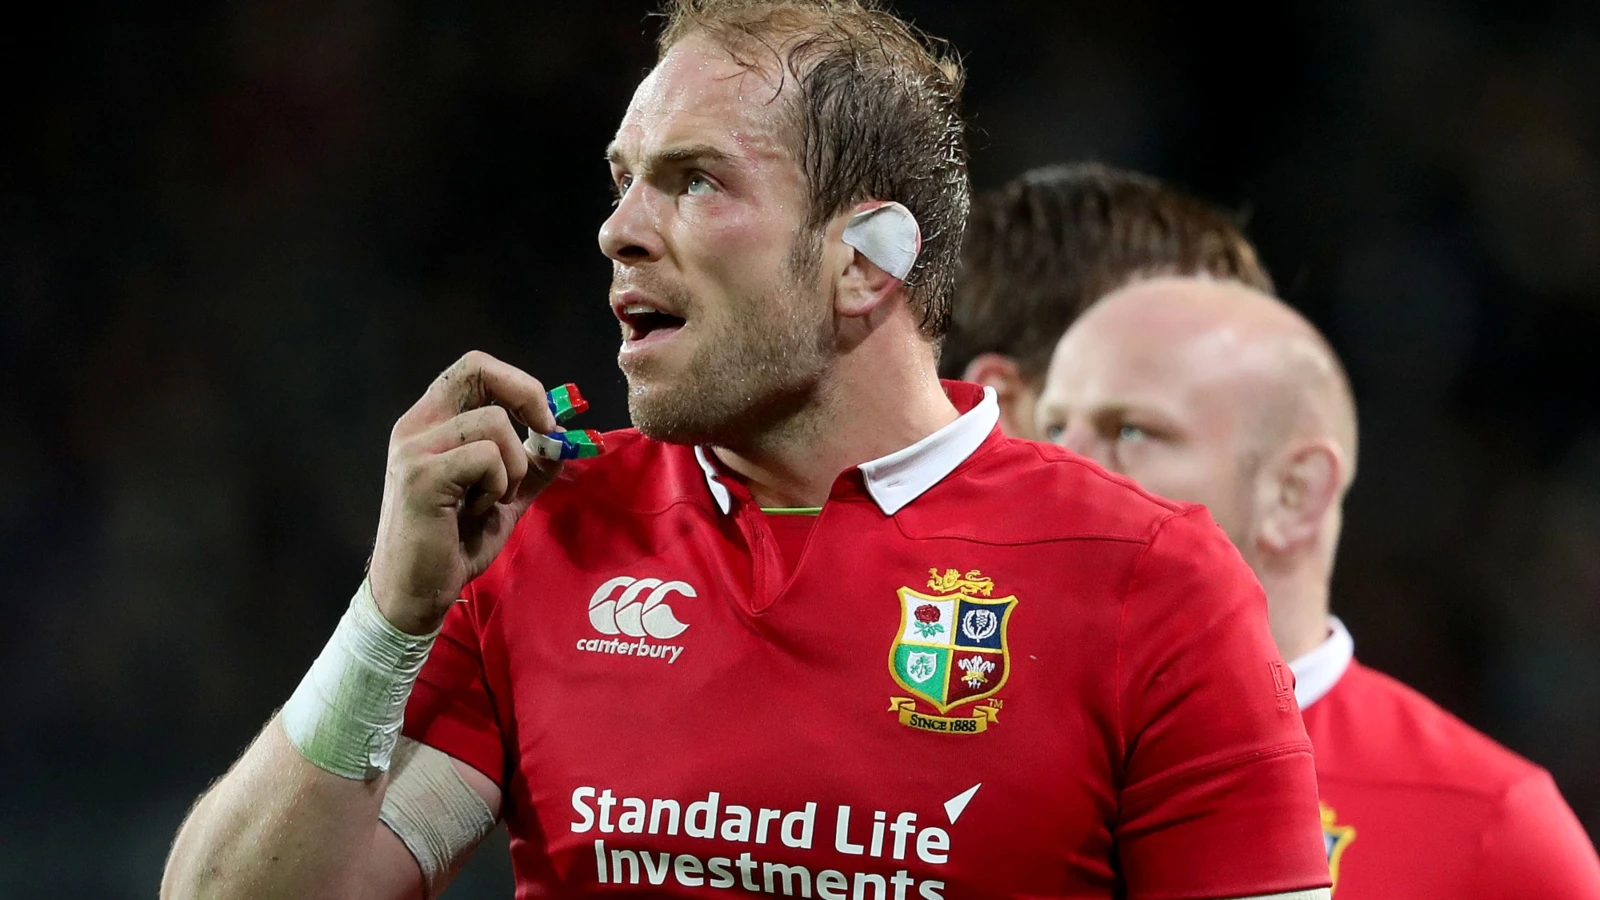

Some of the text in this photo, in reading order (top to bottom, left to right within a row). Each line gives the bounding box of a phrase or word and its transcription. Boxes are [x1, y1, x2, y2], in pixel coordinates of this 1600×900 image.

[576, 637, 685, 665] canterbury
[987, 698, 1003, 709] TM
[909, 714, 977, 732] SINCE 1888
[570, 785, 951, 865] Standard Life
[594, 838, 946, 900] Investments
